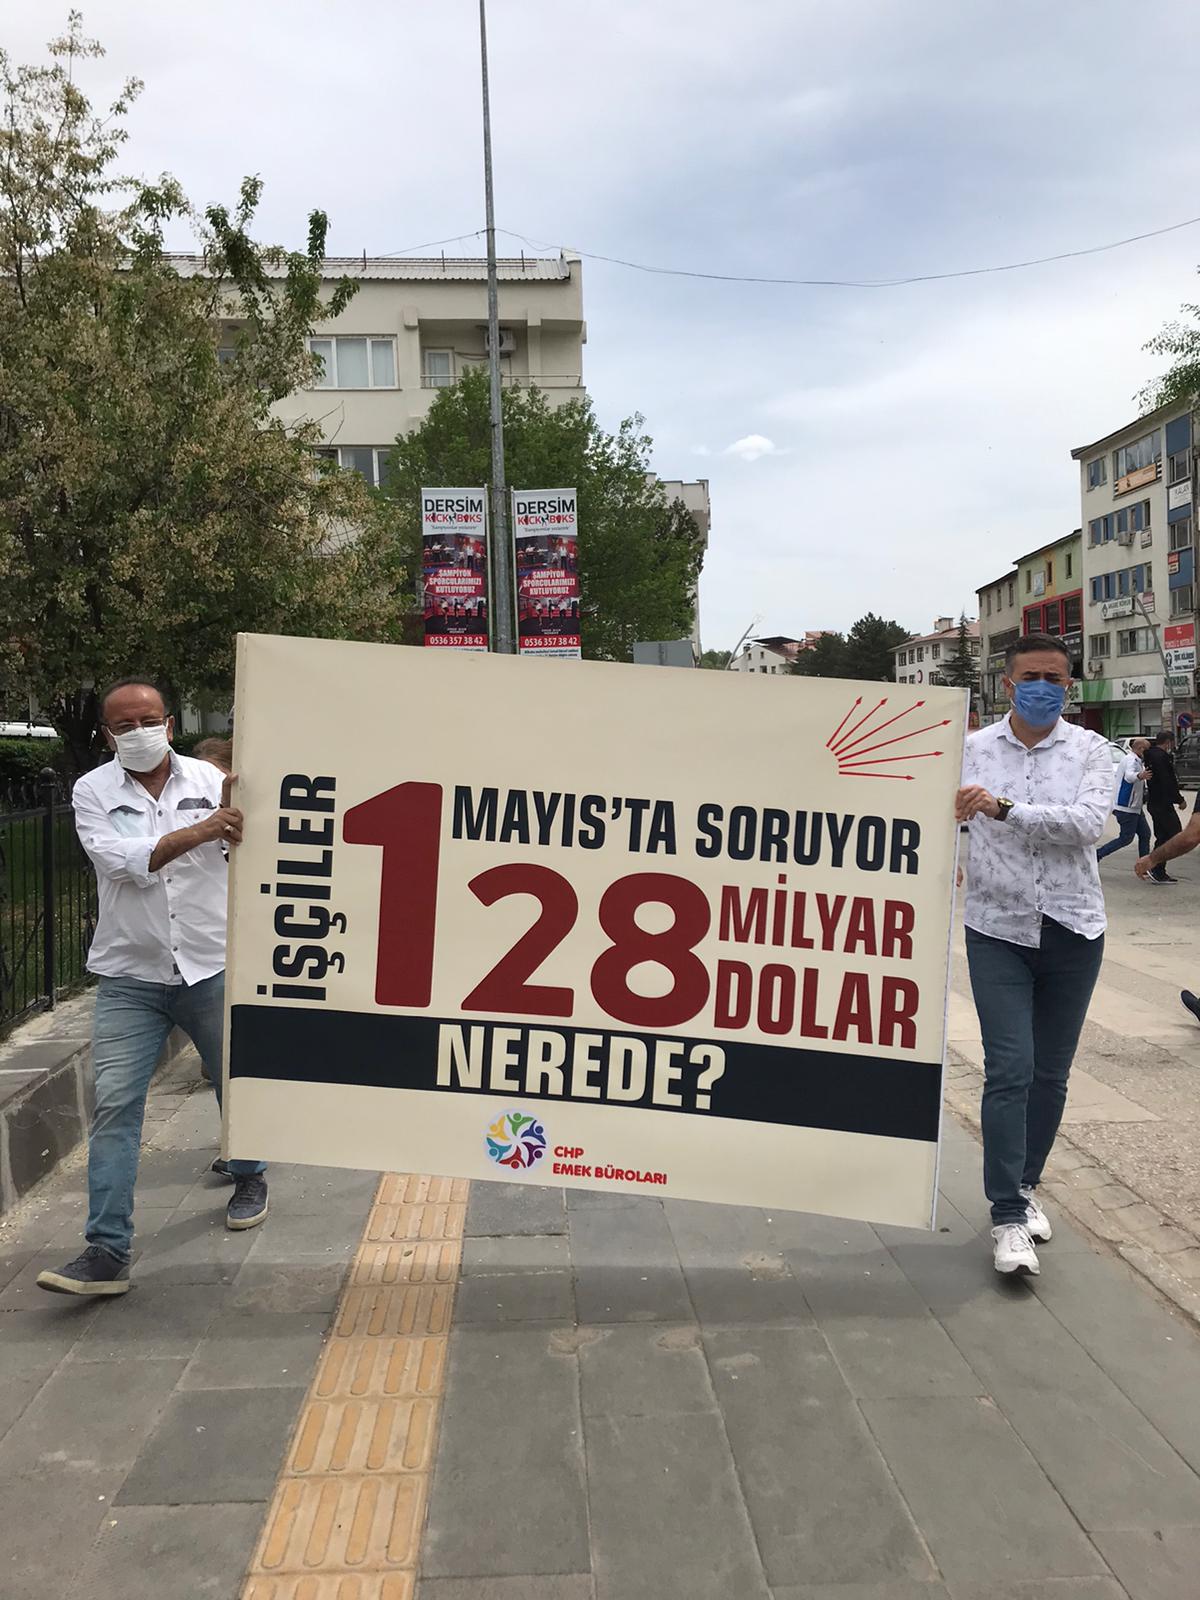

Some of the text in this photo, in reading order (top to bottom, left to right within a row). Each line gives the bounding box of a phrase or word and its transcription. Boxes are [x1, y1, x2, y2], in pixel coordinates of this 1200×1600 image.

[424, 496, 483, 513] DERSİM
[516, 496, 575, 515] DERSİM
[429, 636, 484, 645] 0536 357 38 42
[524, 636, 578, 647] 0536 357 38 42
[451, 785, 921, 875] MAYIS'TA SORUYOR
[257, 774, 347, 1001] İŞÇİLER
[718, 873, 916, 960] MİLYAR
[713, 959, 921, 1050] DOLAR
[436, 1023, 727, 1111] NEREDE?
[553, 1145, 585, 1160] CHP
[551, 1163, 668, 1185] EMEK BÜROLARI
